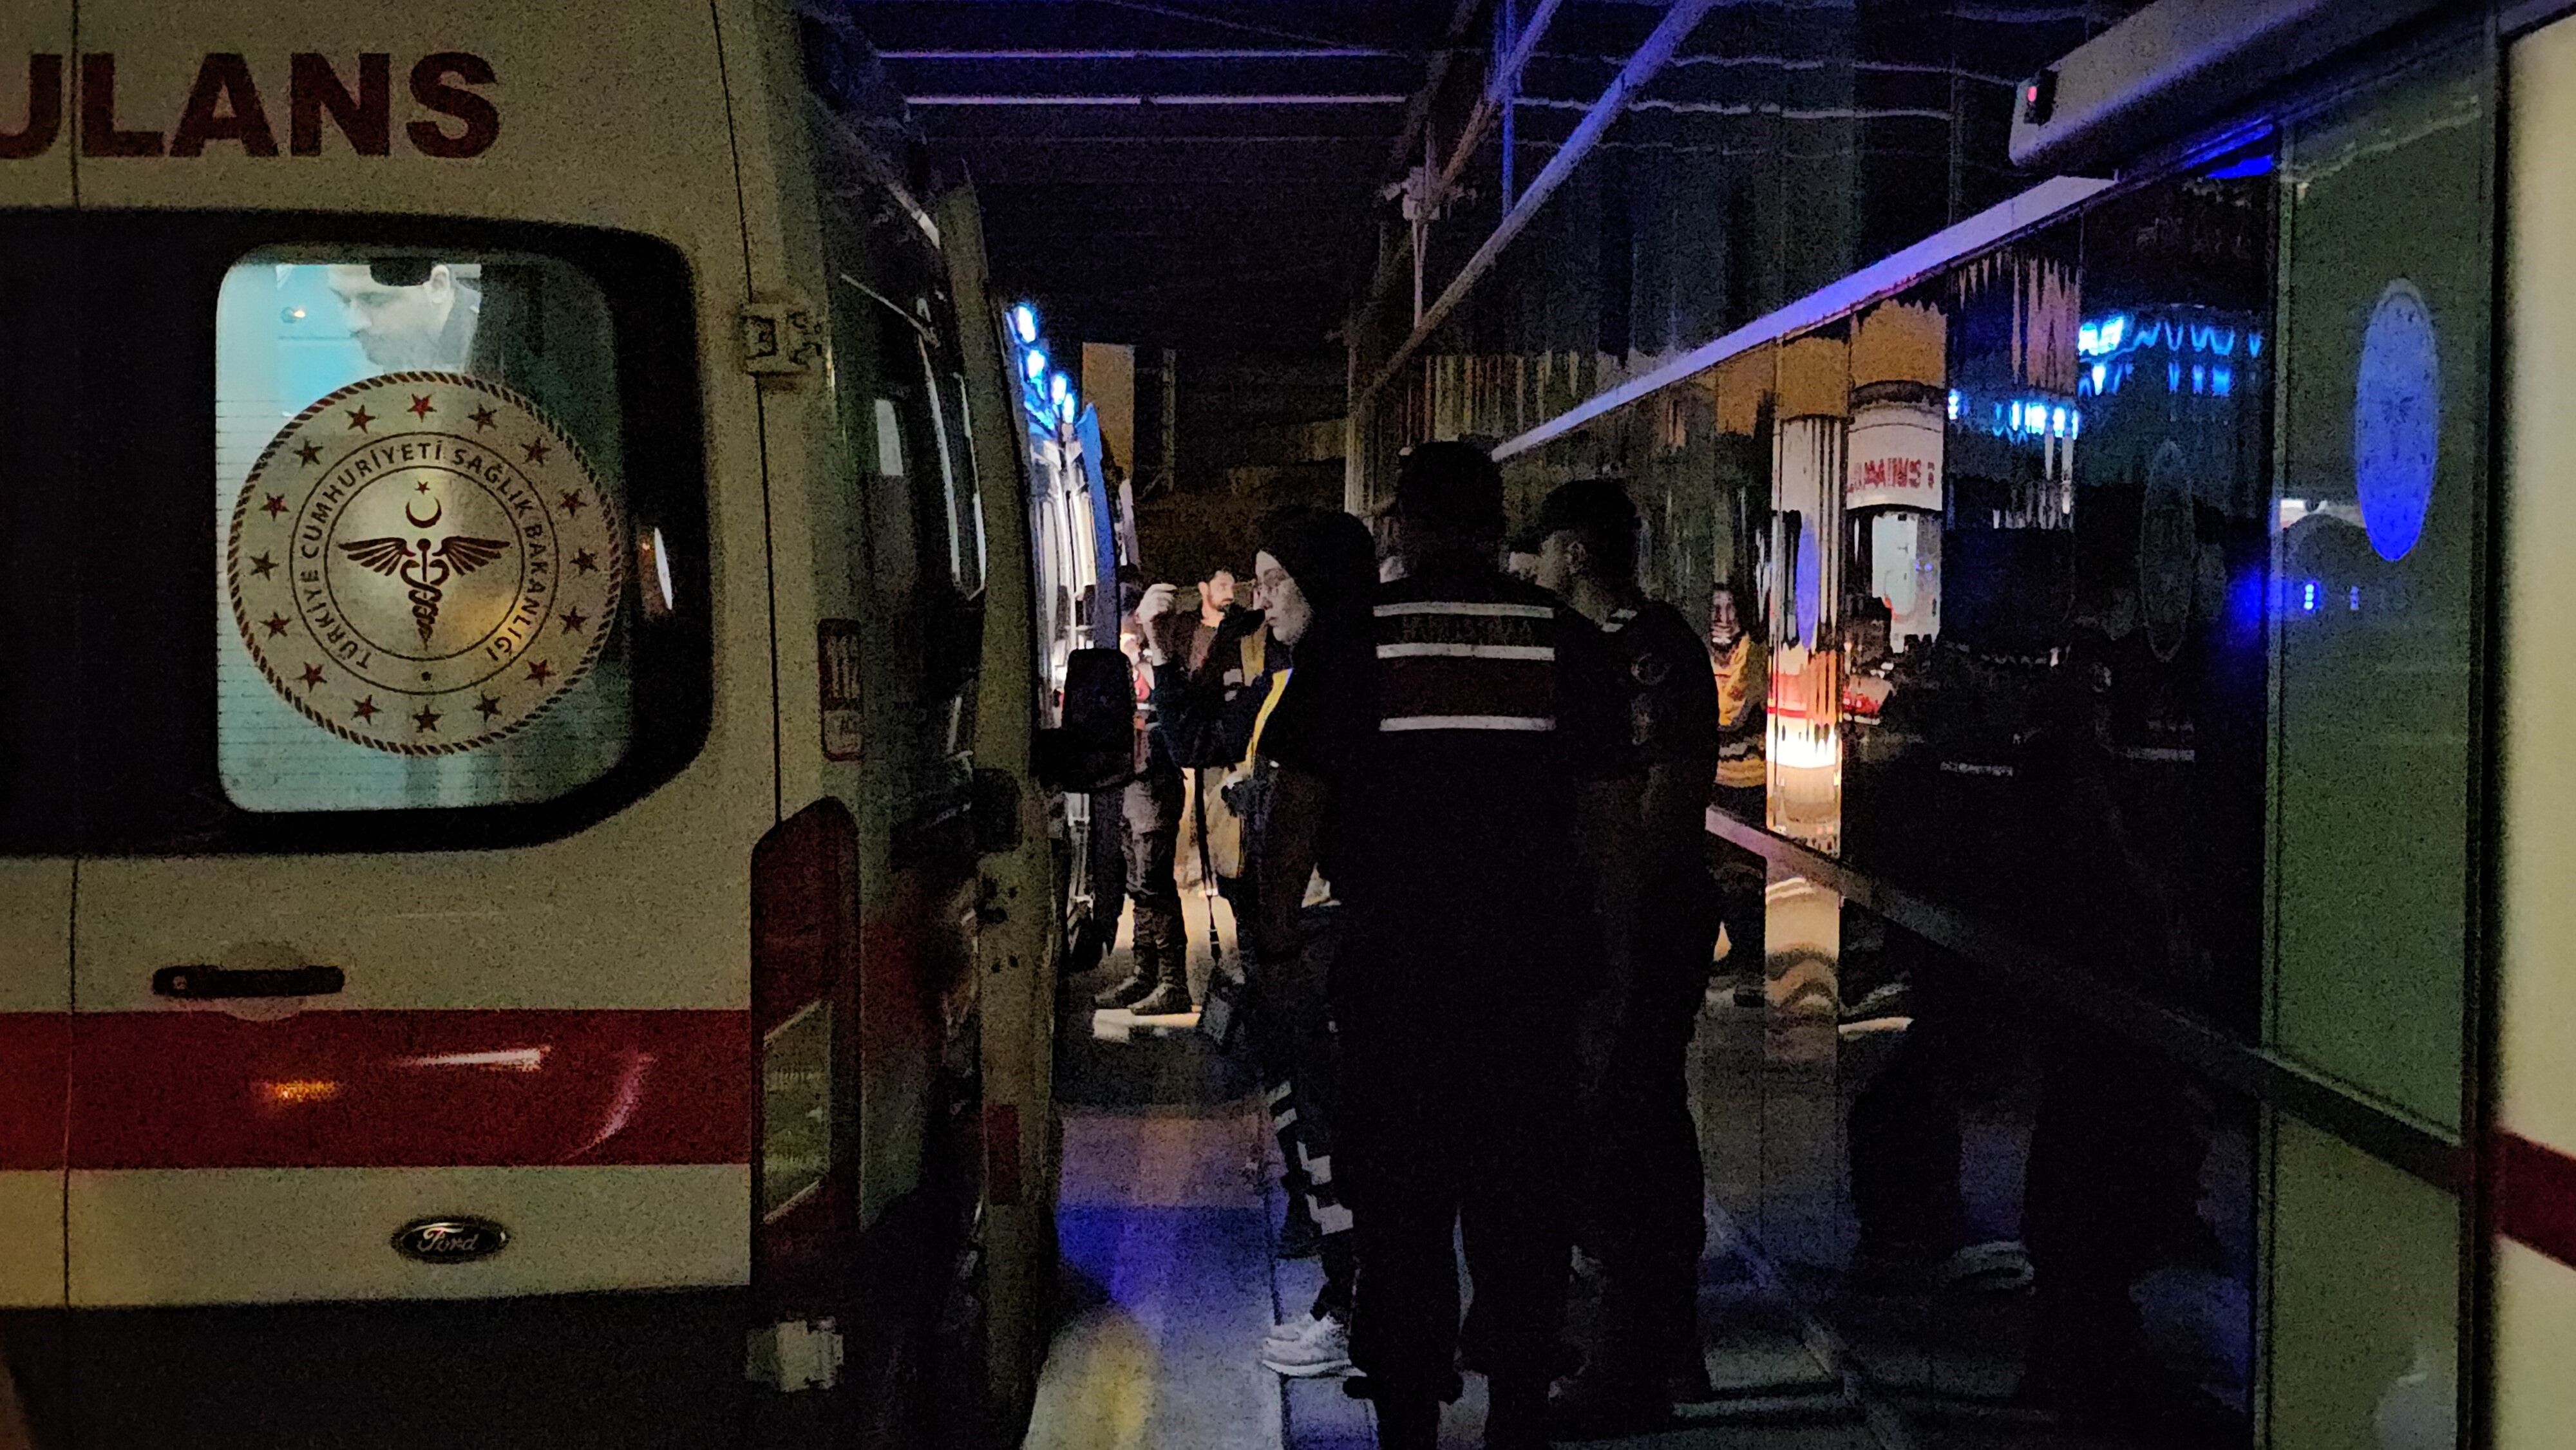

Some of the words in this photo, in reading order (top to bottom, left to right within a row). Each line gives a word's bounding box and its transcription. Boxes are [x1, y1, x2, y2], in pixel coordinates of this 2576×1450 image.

[301, 440, 443, 559] CUMHURİYETİ
[451, 449, 534, 520] SAĞLIK
[299, 569, 372, 670] TÜRKİYE
[416, 1226, 480, 1252] Ford
